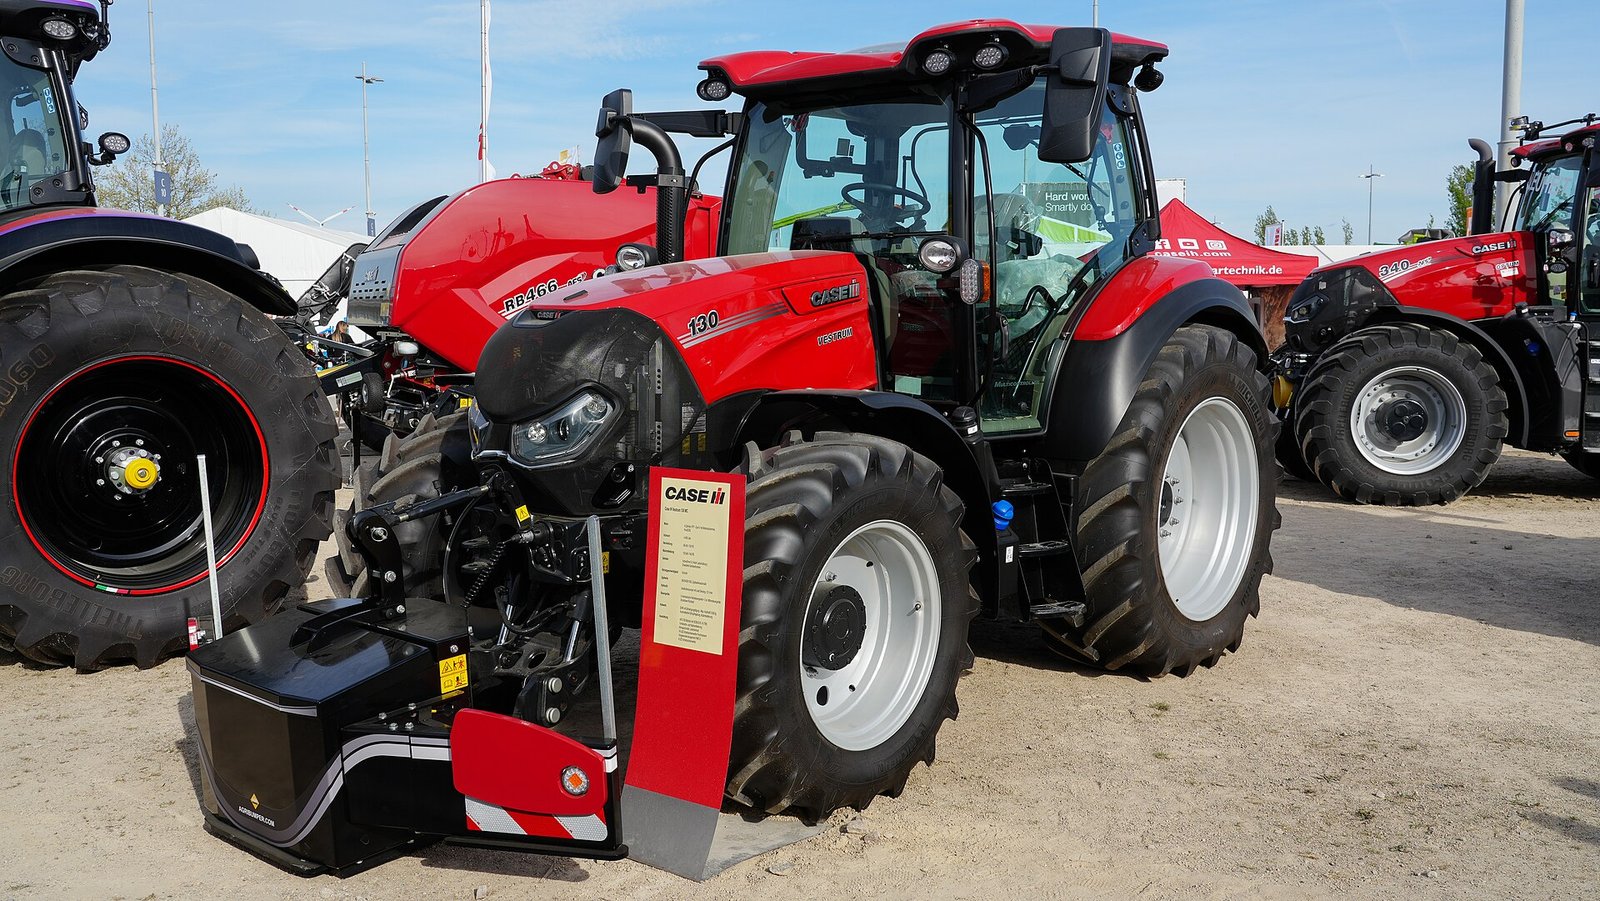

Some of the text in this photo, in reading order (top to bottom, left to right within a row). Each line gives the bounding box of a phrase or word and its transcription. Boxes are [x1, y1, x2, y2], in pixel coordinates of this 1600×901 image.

[1045, 192, 1090, 201] Hard wor
[1045, 202, 1078, 213] Smartly
[1472, 242, 1505, 254] CASE
[1380, 260, 1409, 277] 340
[811, 284, 849, 306] CASE
[537, 311, 555, 319] CASE
[688, 311, 719, 336] 130
[818, 327, 853, 346] VESTRUM
[1235, 376, 1265, 434] MICHELIN
[665, 486, 709, 503] CASE
[1, 566, 142, 640] TRELLEBORG
